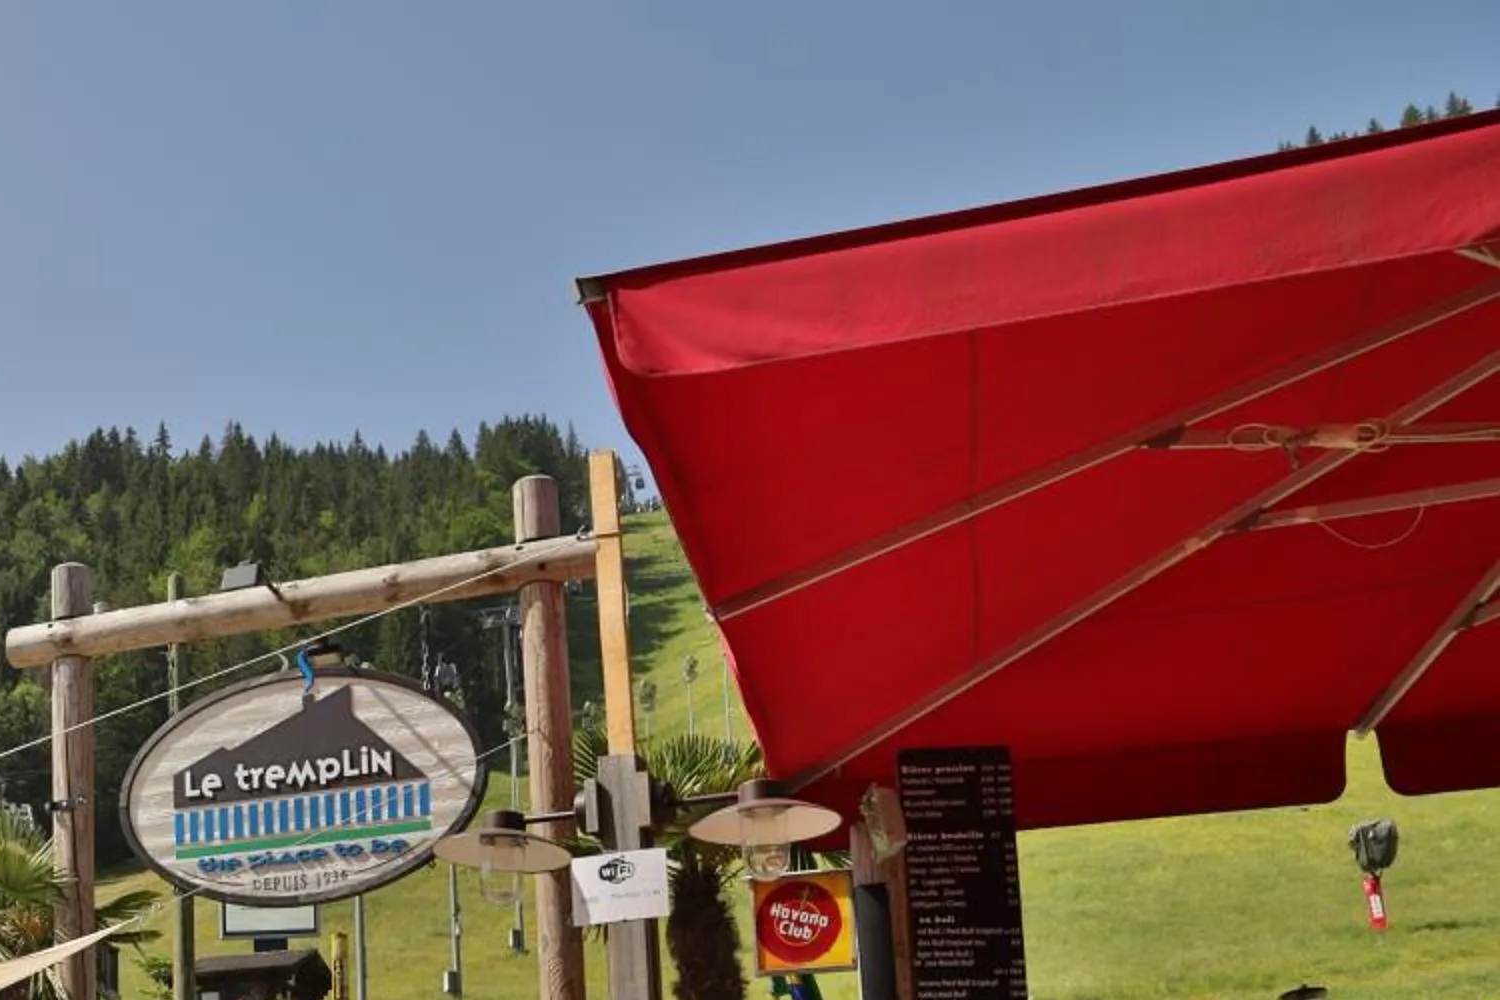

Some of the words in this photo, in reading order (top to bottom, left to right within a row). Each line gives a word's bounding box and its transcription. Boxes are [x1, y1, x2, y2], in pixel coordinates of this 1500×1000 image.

[184, 769, 223, 798] Le
[253, 876, 308, 892] DEPUIS
[770, 900, 829, 928] Havana
[779, 920, 813, 939] Club
